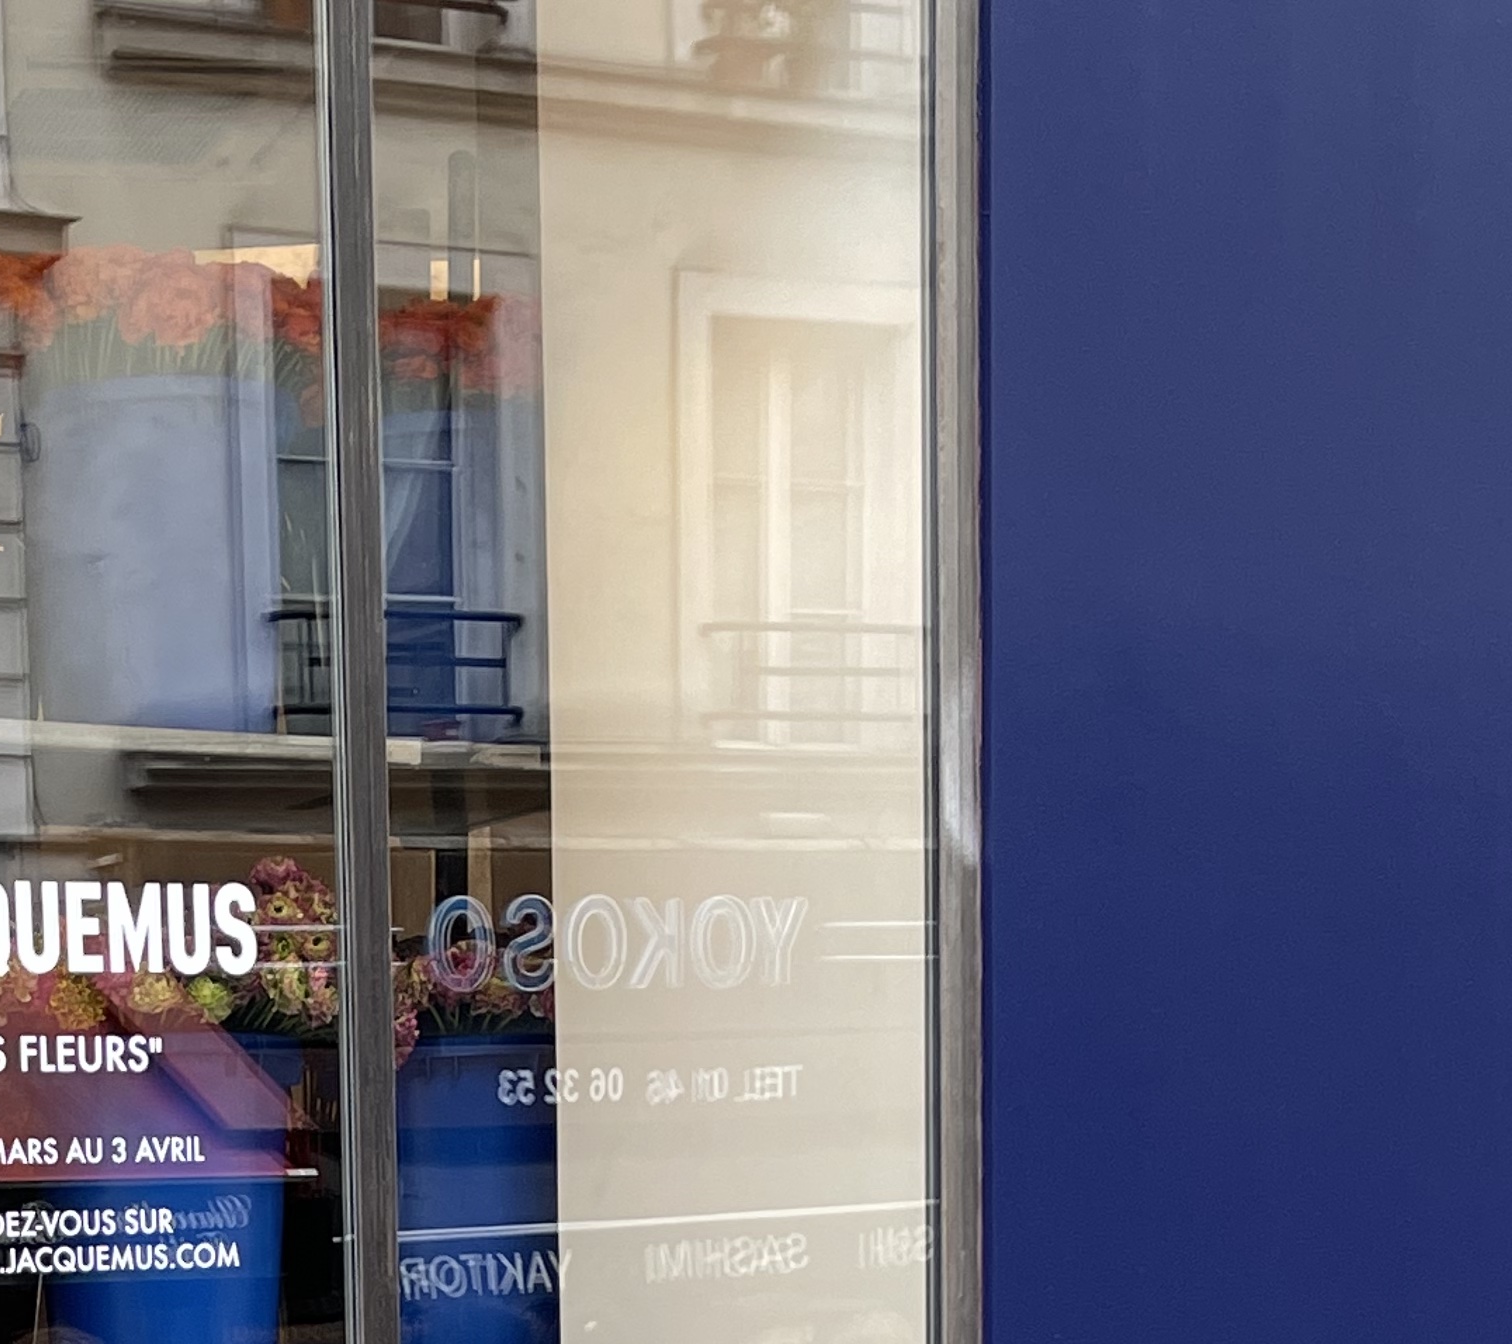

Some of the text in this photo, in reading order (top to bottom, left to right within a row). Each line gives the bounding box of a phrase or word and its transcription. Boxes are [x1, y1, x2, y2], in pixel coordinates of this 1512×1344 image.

[20, 1034, 163, 1074] FLEURS"
[65, 1136, 103, 1165] AU
[111, 1136, 127, 1165] 3
[134, 1135, 205, 1163] AVRIL
[124, 1206, 175, 1236] SUR
